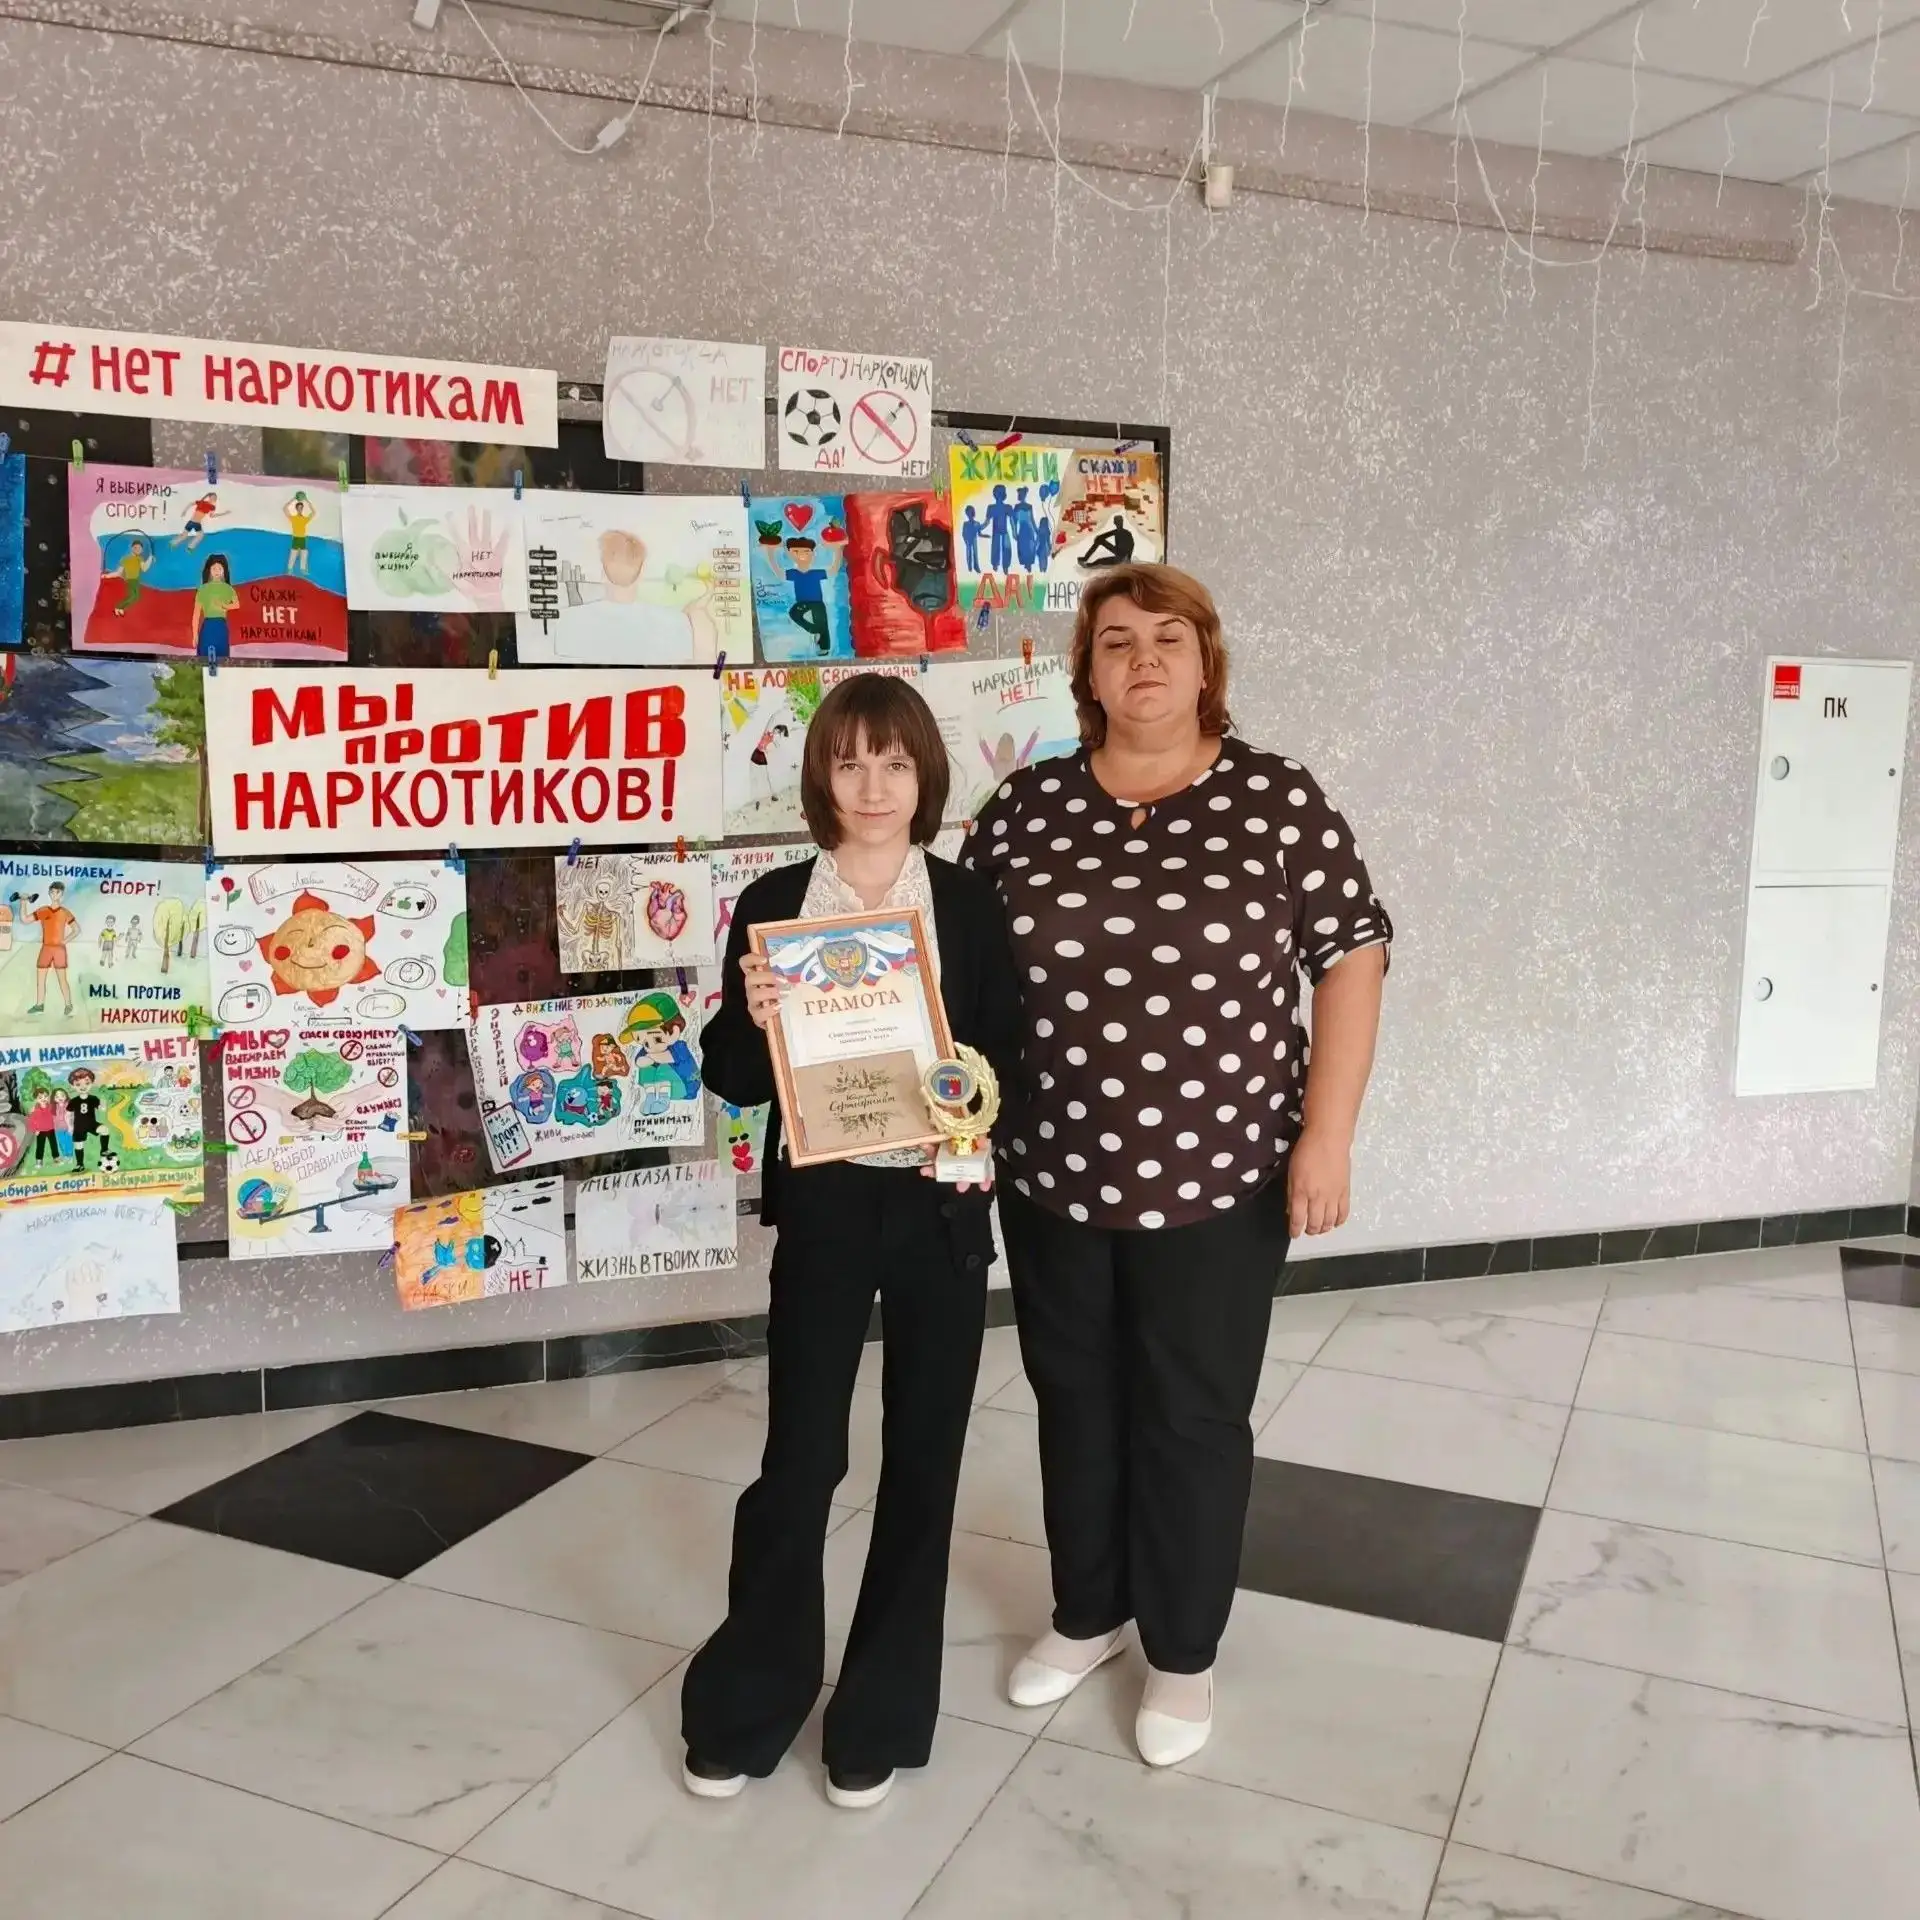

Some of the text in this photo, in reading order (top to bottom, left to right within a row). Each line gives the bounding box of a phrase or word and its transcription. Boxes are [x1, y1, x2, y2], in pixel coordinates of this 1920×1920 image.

[780, 350, 848, 380] СПОРТУ
[205, 354, 524, 425] наркотикам
[814, 446, 846, 469] ДА!
[959, 451, 1060, 482] ЖИЗНИ
[1078, 459, 1138, 476] СКАЖИ
[901, 460, 930, 476] НЕТ!
[96, 478, 105, 493] Я
[105, 501, 168, 521] СПОРТ!
[471, 551, 492, 563] НЕТ
[973, 572, 1034, 609] ДА!
[1047, 581, 1084, 609] НАРК
[262, 606, 299, 625] НЕТ
[240, 626, 322, 642] НАРКОТИКАМ!
[727, 671, 756, 691] НЕ
[1000, 679, 1041, 704] НЕТ!
[251, 683, 414, 746] МЫ
[1824, 697, 1848, 718] ПК
[344, 685, 687, 765] ПРОТИВ
[232, 760, 677, 830] НАРКОТИКОВ!
[576, 853, 709, 869] НЕТ НАРКОТКАМ!
[732, 849, 809, 865] ЖИВИ БЕЗ
[100, 880, 162, 896] СПОРТ!
[127, 986, 181, 1000] ПРОТИВ
[804, 990, 902, 1016] ГРАМОТА
[101, 1005, 204, 1024] НАРКОТИКО!
[576, 1000, 594, 1009] ЭТО
[364, 1030, 399, 1039] МЕЧТУ
[0, 1050, 31, 1066] АЖИ
[40, 1044, 125, 1061] НАРКОТИКАМ
[143, 1036, 200, 1061] НЕТ!
[225, 1049, 287, 1065] ВЫБИРАЕМ
[228, 1065, 281, 1081] ЖИЗНЬ
[347, 1132, 366, 1142] НЕТ
[535, 1129, 561, 1142] ЖИВИ
[273, 1146, 316, 1173] ВЫБОР
[0, 1179, 48, 1197] ыбирай
[54, 1175, 96, 1191] спорт!
[102, 1172, 156, 1187] Выбирай
[625, 1165, 693, 1188] СКАЗАТЬ
[578, 1255, 637, 1279] ЖИЗНЬ
[640, 1255, 650, 1273] В
[653, 1250, 700, 1272] ТВОИХ
[509, 1267, 548, 1292] НЕТ
